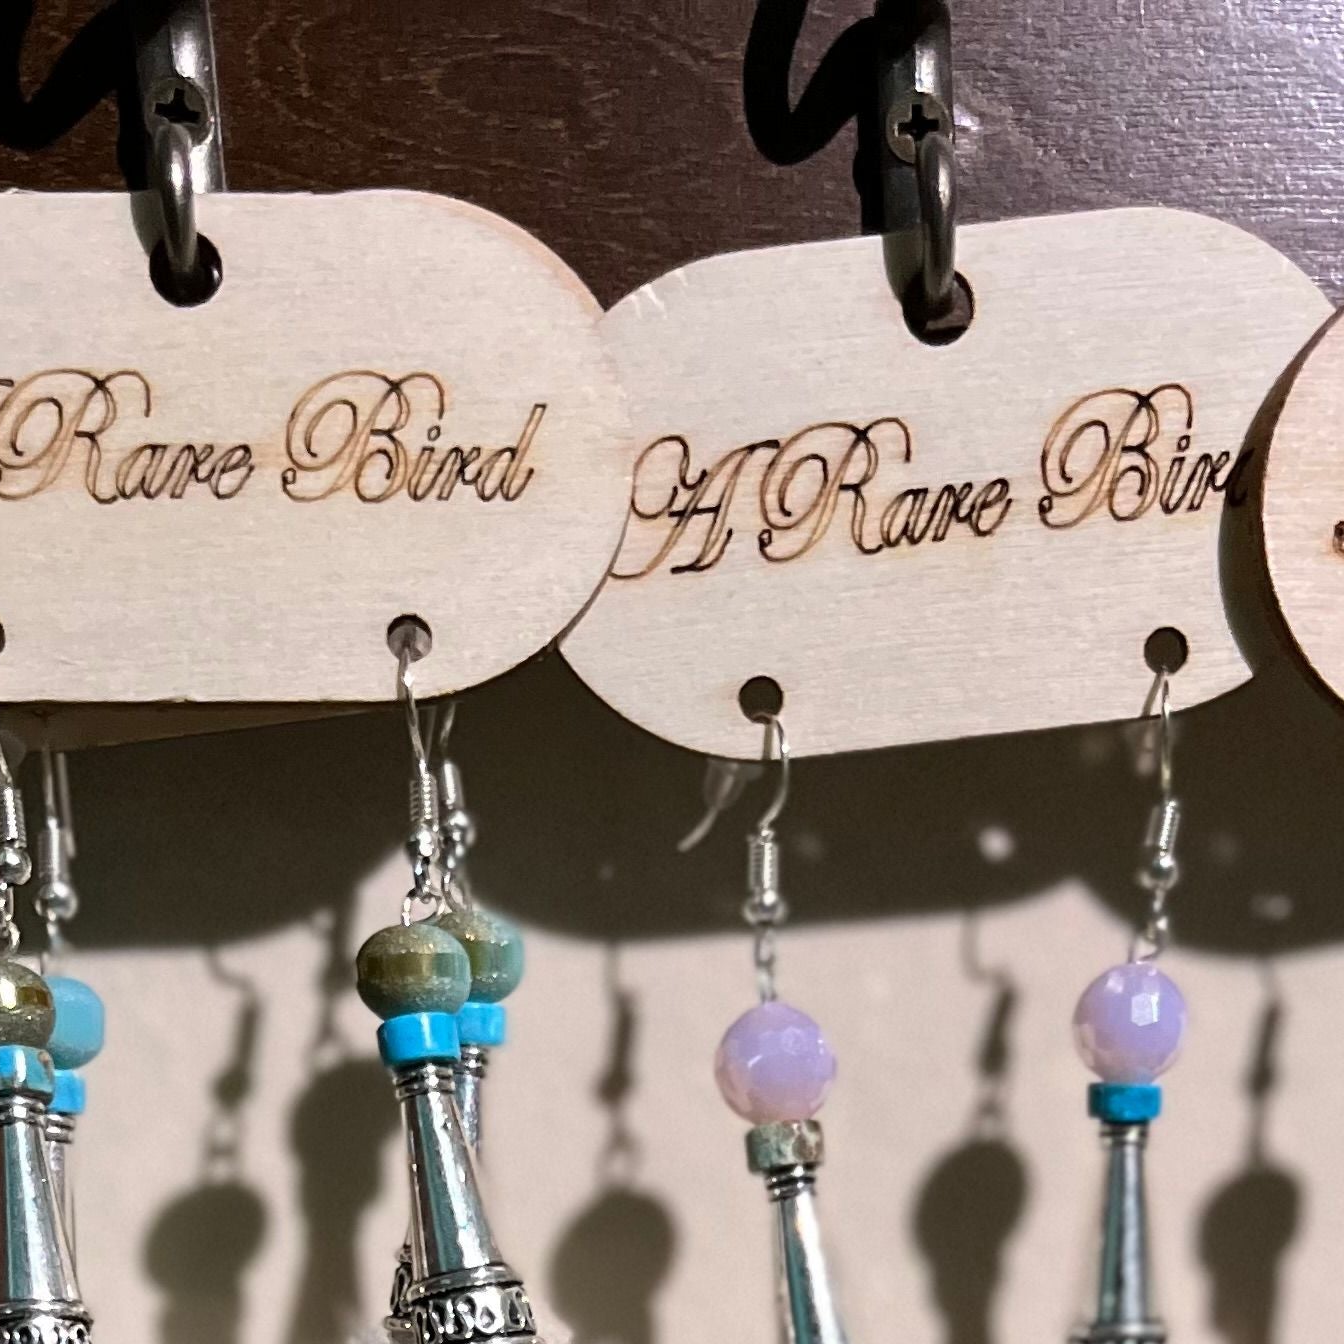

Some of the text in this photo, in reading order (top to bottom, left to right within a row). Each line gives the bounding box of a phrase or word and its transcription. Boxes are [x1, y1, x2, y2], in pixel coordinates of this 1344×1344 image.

[281, 369, 547, 504] Bird
[607, 434, 781, 579] A
[758, 416, 1013, 563] Rare
